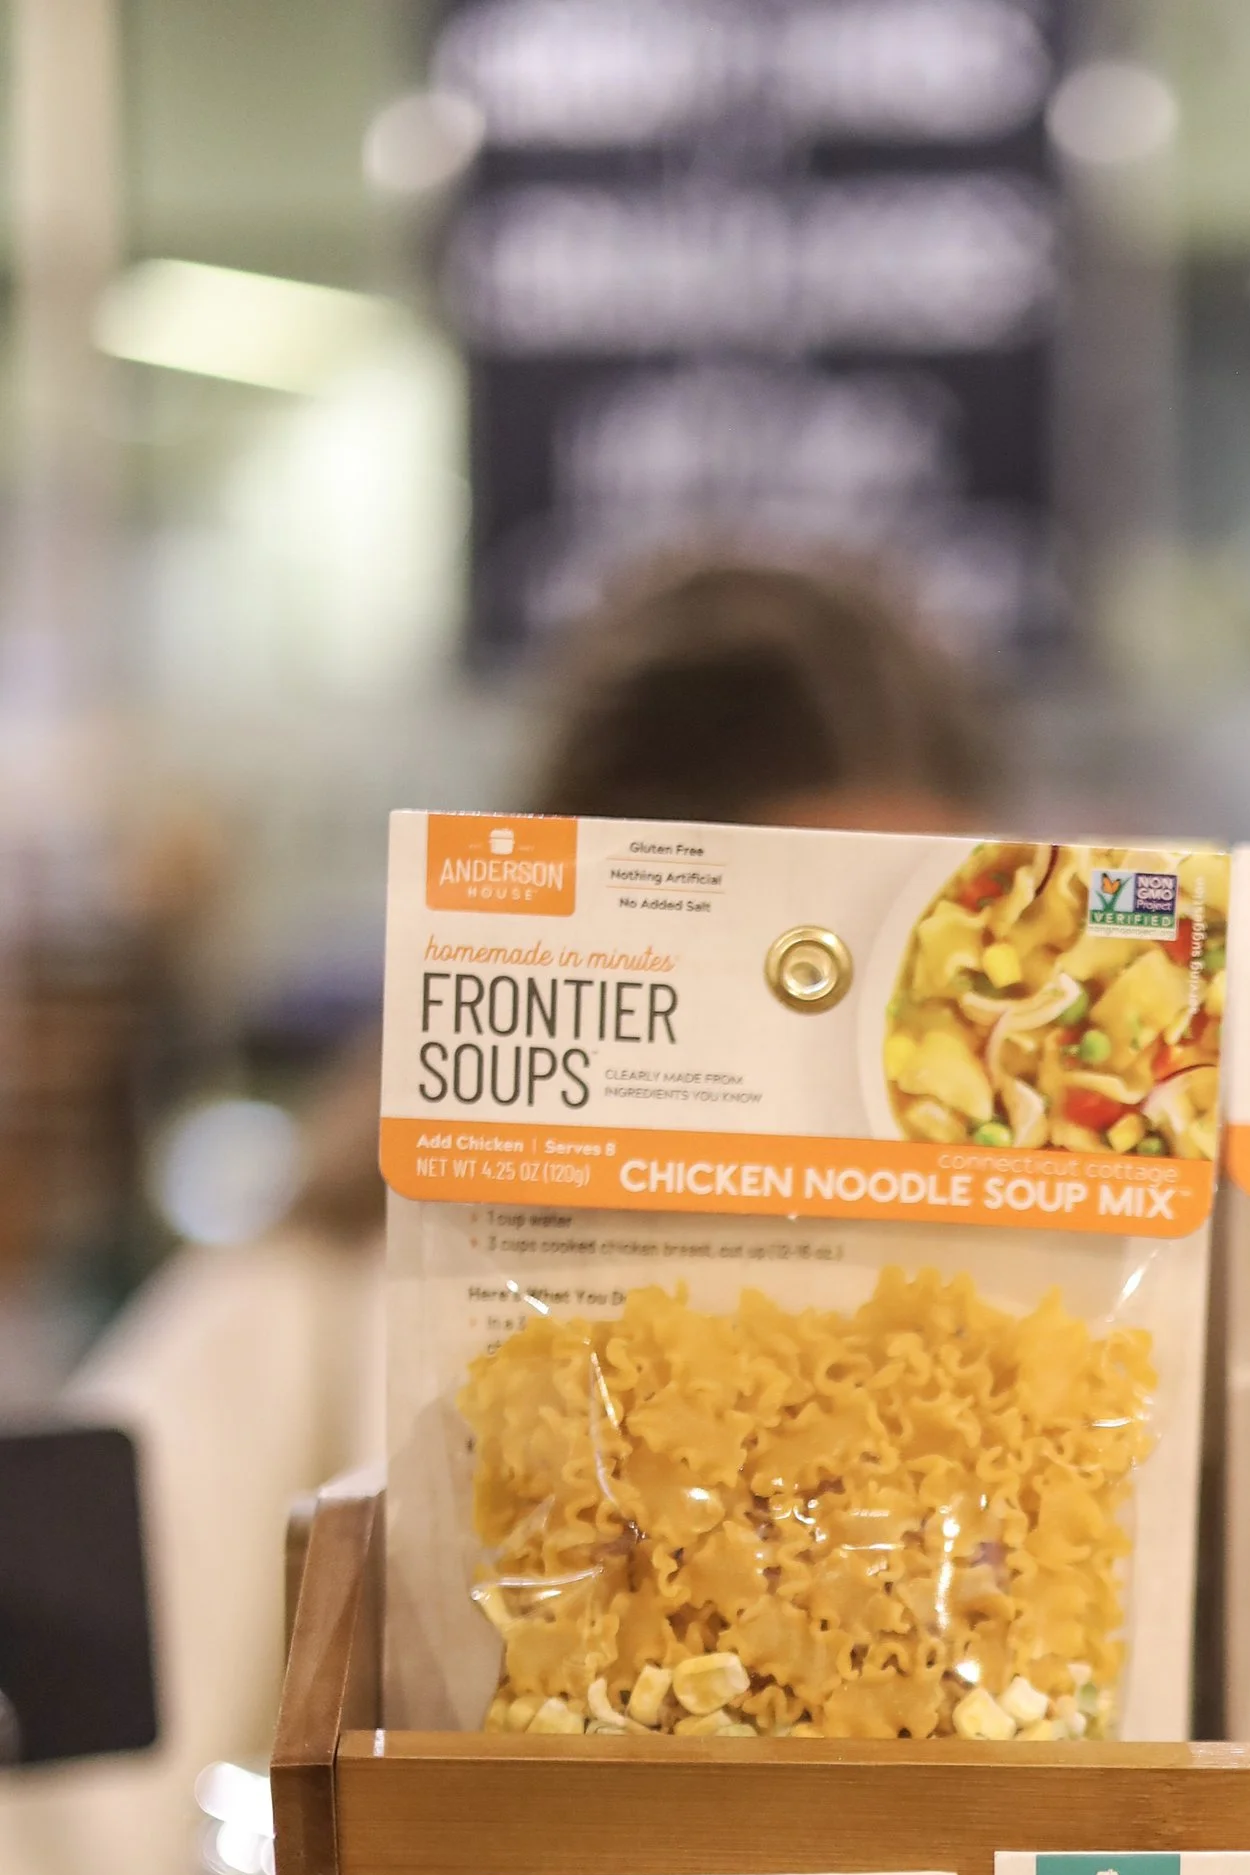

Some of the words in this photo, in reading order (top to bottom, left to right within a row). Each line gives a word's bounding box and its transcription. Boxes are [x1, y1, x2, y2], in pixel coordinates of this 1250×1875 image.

[630, 842, 672, 856] Gluten
[676, 845, 704, 857] Free
[440, 859, 564, 891] ANDERSON
[610, 869, 662, 886] Nothing
[665, 872, 722, 885] Artificial
[1138, 876, 1173, 889] NON
[468, 887, 534, 901] HOUSE
[1137, 889, 1173, 900] GMO
[619, 898, 637, 909] No
[641, 898, 683, 911] Added
[687, 900, 710, 912] Salt
[1136, 900, 1172, 912] Project
[1094, 913, 1173, 926] VERIFIED
[423, 934, 554, 966] homemade
[560, 950, 580, 968] in
[587, 945, 676, 972] minutes
[422, 972, 678, 1045] FRONTIER
[416, 1135, 452, 1150] Add
[456, 1136, 524, 1153] Chicken
[544, 1139, 601, 1155] Serves
[416, 1158, 446, 1178] NET
[453, 1159, 477, 1179] WT
[481, 1160, 516, 1181] 4.25
[520, 1162, 542, 1182] OZ
[938, 1152, 1079, 1177] connecticut
[1085, 1161, 1179, 1184] cottage
[620, 1159, 794, 1198] CHICKEN
[805, 1168, 972, 1207] NOODLE
[984, 1175, 1087, 1213] SOUP
